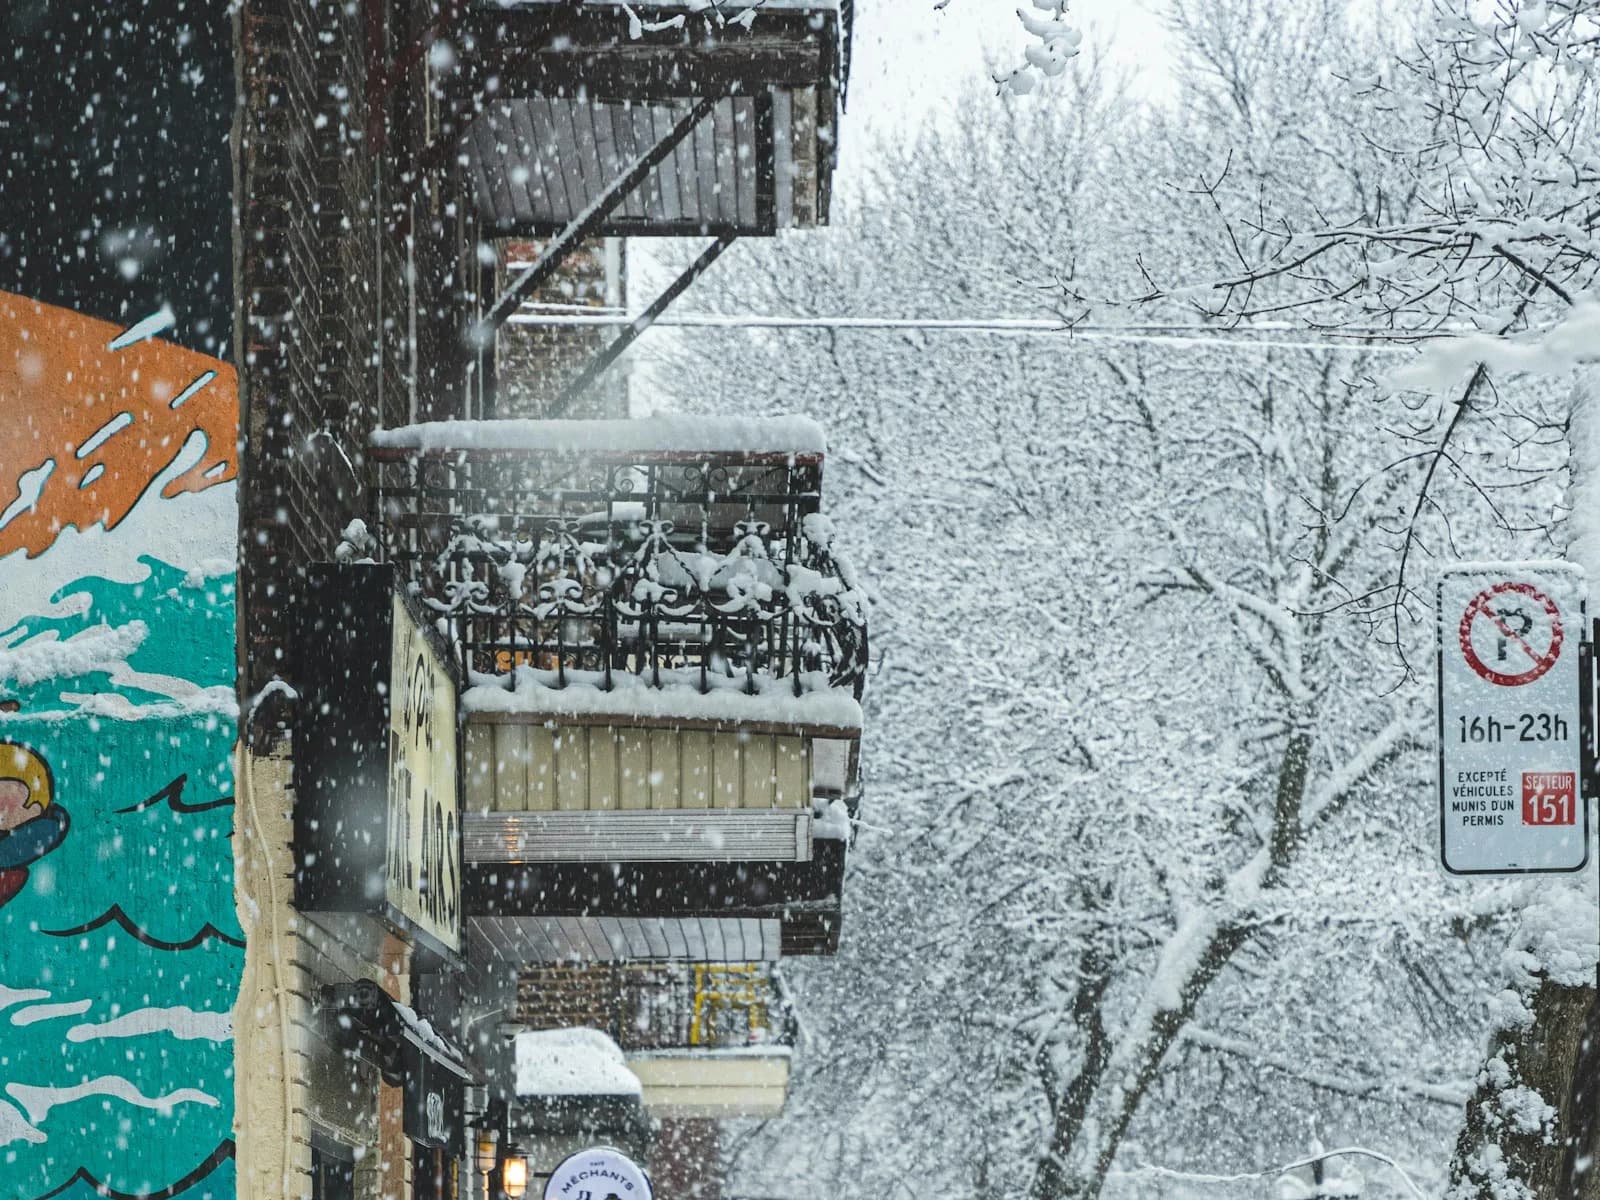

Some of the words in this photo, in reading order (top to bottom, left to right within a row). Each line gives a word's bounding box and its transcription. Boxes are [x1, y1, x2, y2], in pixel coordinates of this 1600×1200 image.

[1459, 713, 1568, 743] 16h-23h
[1457, 768, 1508, 783] EXCEPTÉ
[1525, 775, 1572, 790] SECTEUR
[1452, 784, 1514, 798] VÉHICULES
[1452, 800, 1487, 812] MUNIS
[1491, 800, 1515, 811] D'UN
[1528, 794, 1569, 823] 151
[1462, 814, 1504, 827] PERMIS
